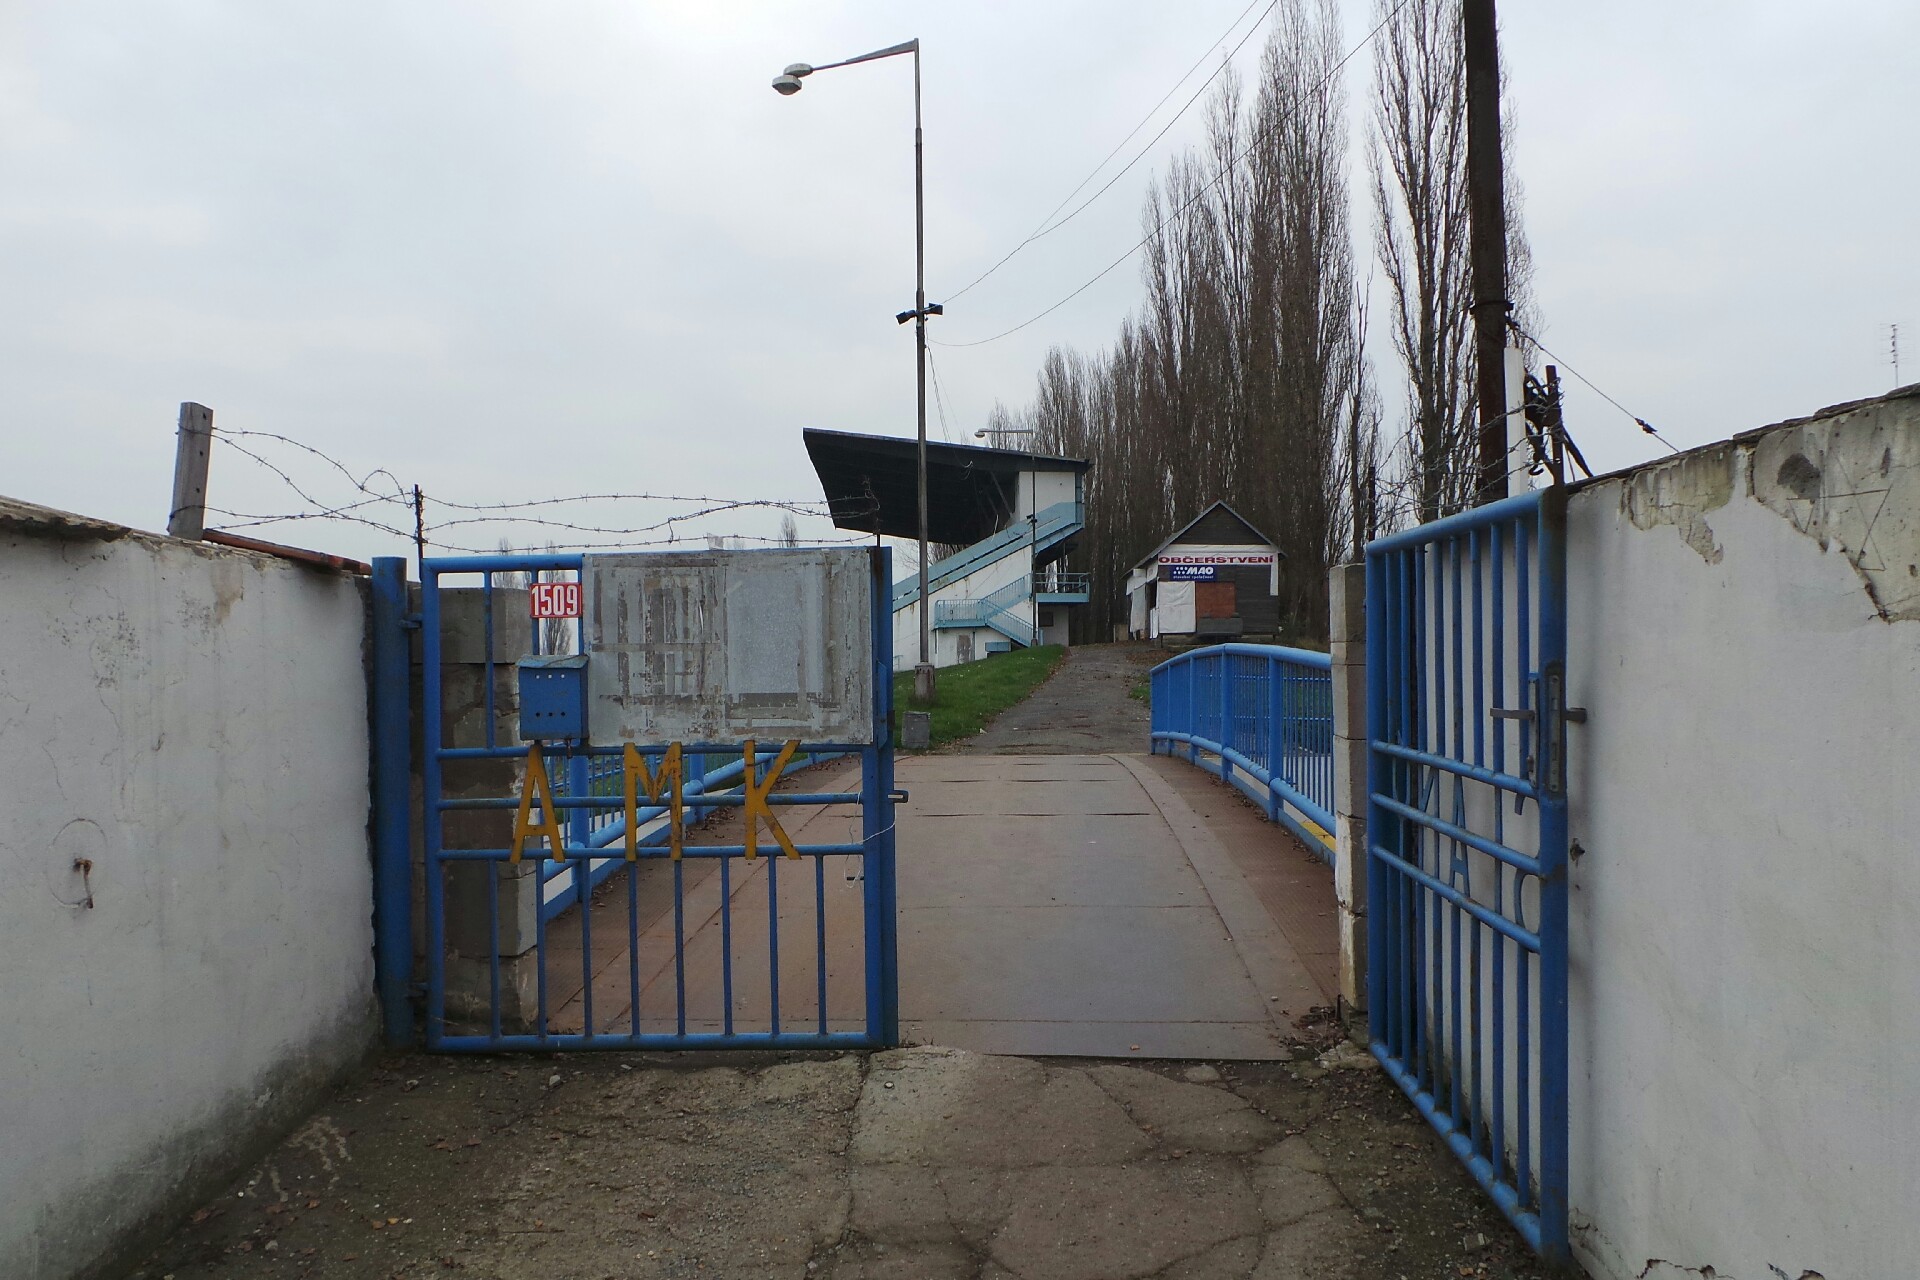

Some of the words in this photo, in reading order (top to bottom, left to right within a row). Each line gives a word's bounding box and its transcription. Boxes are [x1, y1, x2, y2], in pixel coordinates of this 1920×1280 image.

[1158, 555, 1273, 563] OBČERSTVENÍ
[1185, 566, 1214, 575] MAO
[531, 585, 578, 616] 1509
[510, 740, 802, 864] AMK
